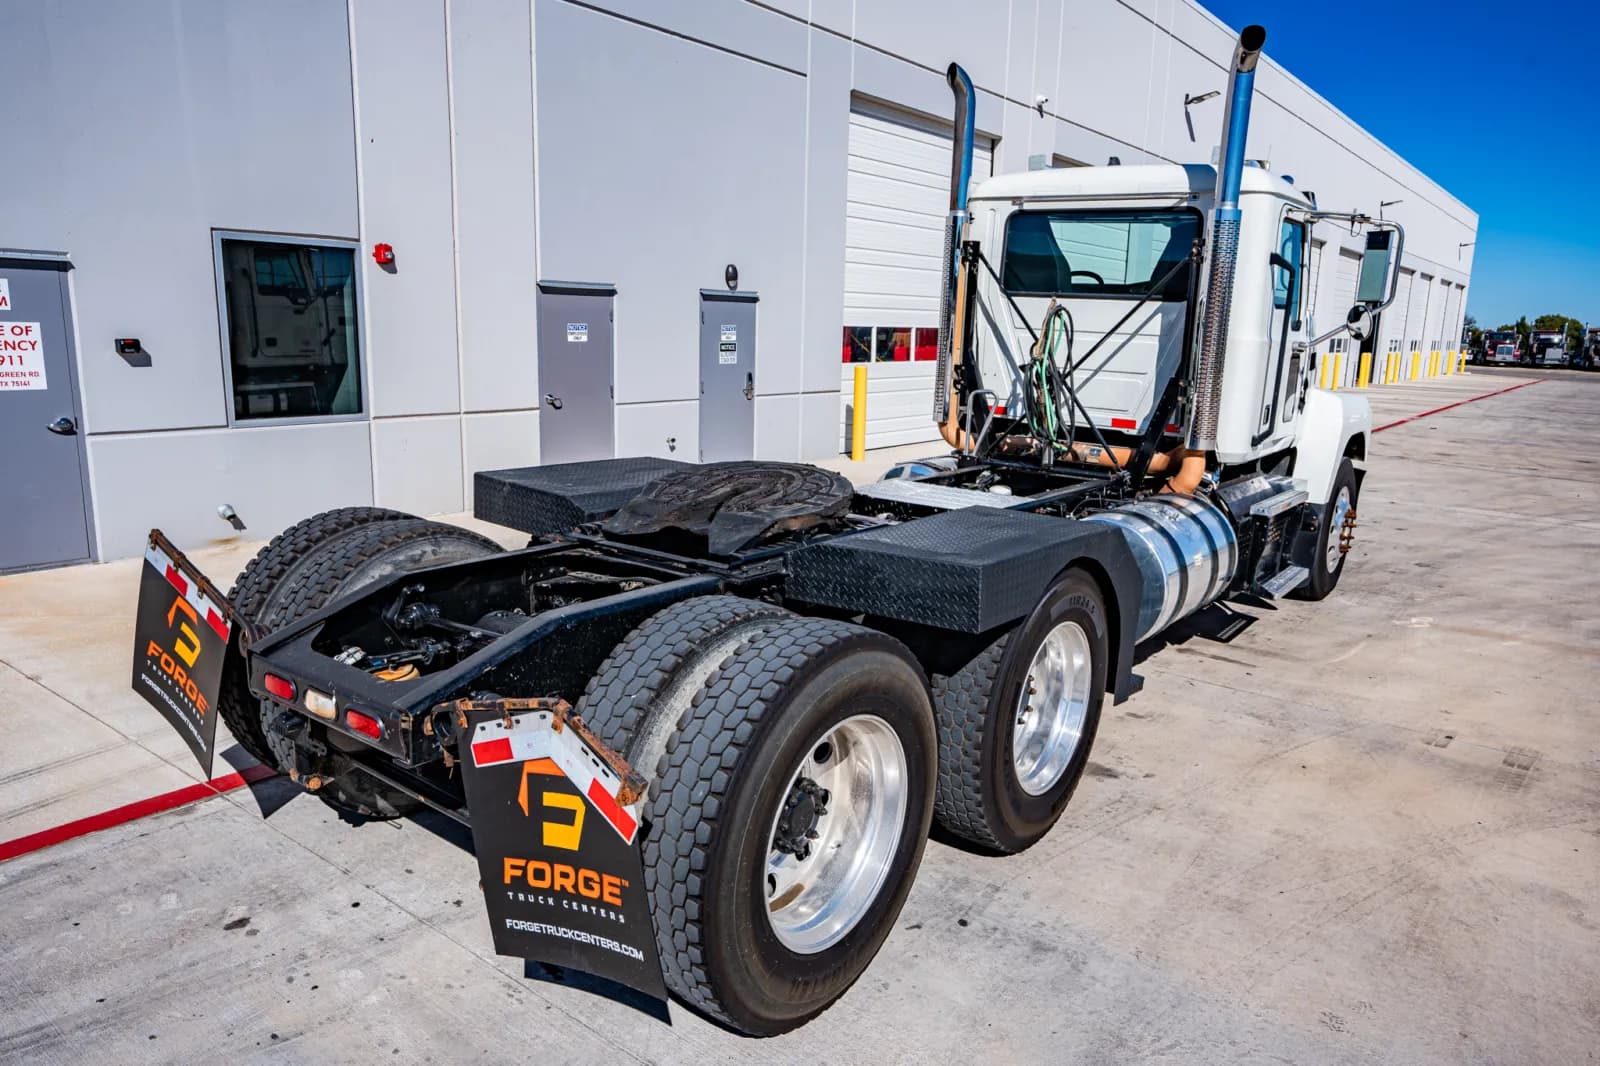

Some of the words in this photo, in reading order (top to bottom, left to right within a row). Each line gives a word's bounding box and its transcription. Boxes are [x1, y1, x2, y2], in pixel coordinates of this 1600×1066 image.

[11, 325, 33, 336] OF
[0, 355, 24, 366] 911
[147, 640, 206, 716] FORGE
[503, 857, 622, 906] FORGE
[507, 891, 555, 906] TRUCK
[562, 900, 625, 923] CENTERS
[505, 918, 645, 961] FORGETRUCKCENTERS.COM
